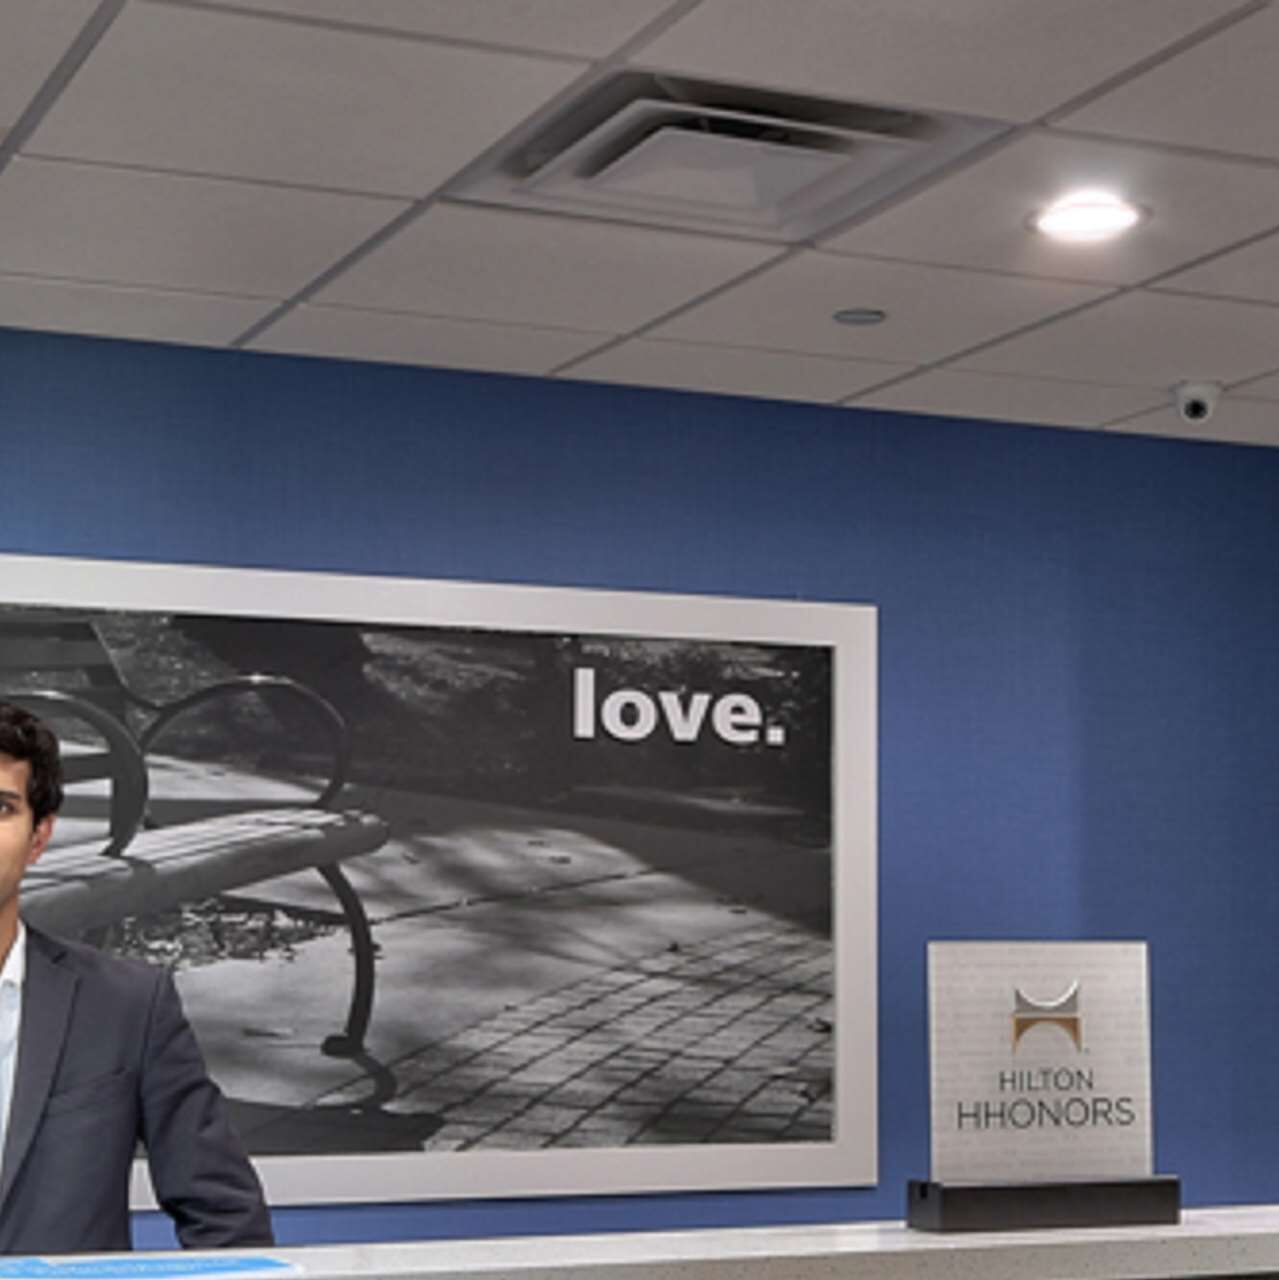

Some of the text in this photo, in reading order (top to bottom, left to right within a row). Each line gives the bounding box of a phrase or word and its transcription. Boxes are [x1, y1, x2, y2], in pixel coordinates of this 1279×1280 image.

[574, 667, 785, 745] love.
[999, 1066, 1094, 1092] HILTON
[957, 1096, 1136, 1130] HHONORS
